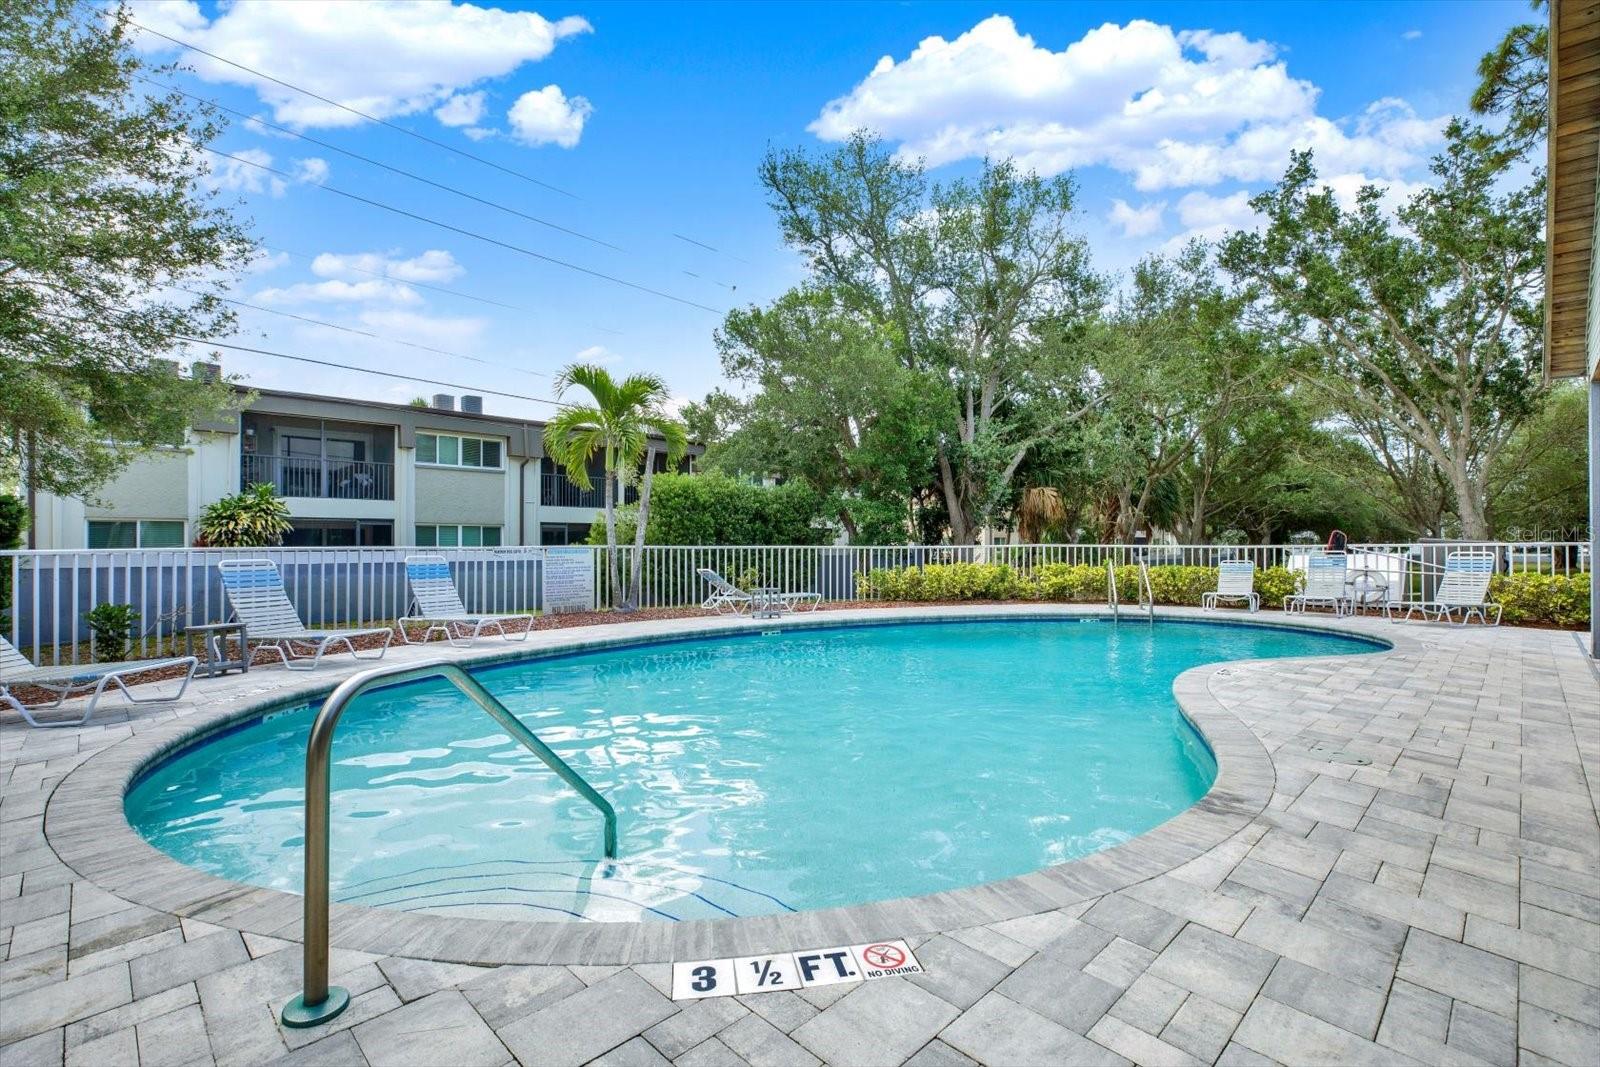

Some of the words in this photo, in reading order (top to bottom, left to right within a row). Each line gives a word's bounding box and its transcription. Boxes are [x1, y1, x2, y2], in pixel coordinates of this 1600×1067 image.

[691, 966, 717, 992] 3
[798, 951, 857, 982] FT.
[867, 969, 883, 978] NO
[885, 965, 919, 976] DIVING
